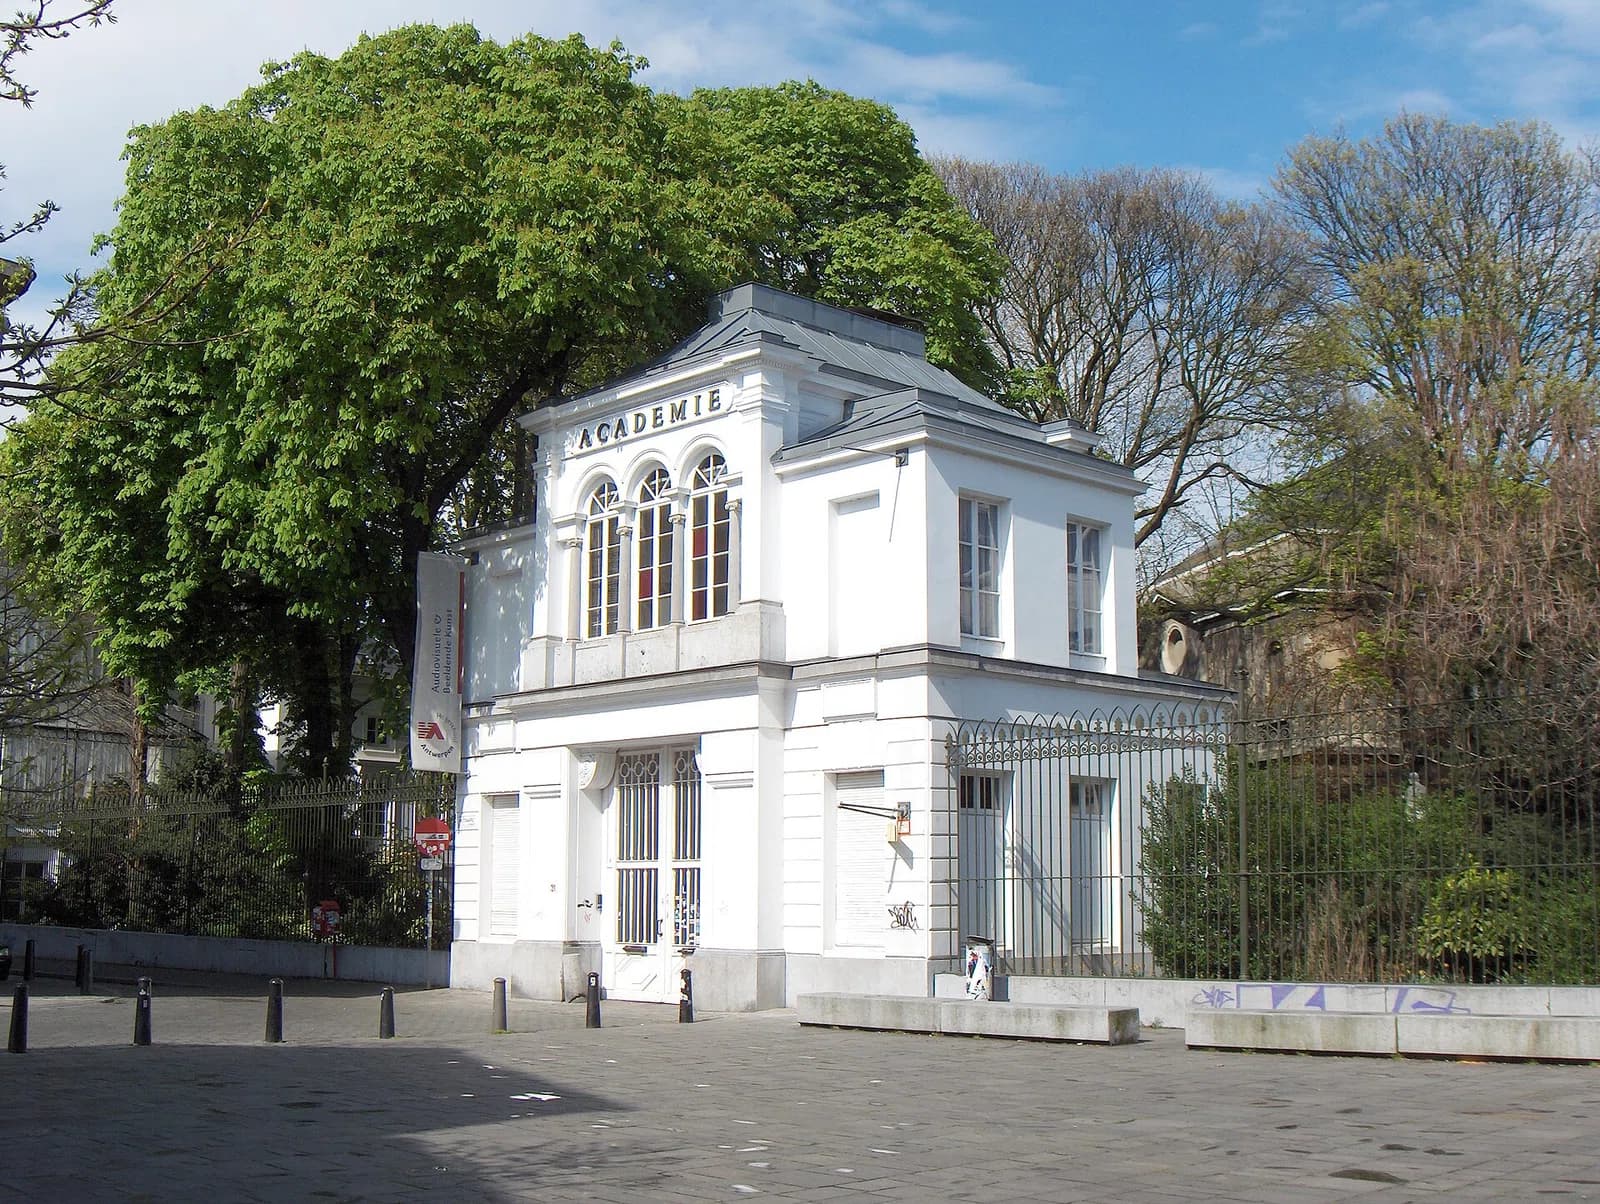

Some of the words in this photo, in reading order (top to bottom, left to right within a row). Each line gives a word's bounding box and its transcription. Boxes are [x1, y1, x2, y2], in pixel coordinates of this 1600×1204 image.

[578, 388, 721, 449] ACADEMIE
[444, 609, 453, 638] Kunst
[431, 628, 442, 694] Audiovisuele
[442, 640, 452, 694] Beeldende
[420, 743, 455, 758] Antwerpen
